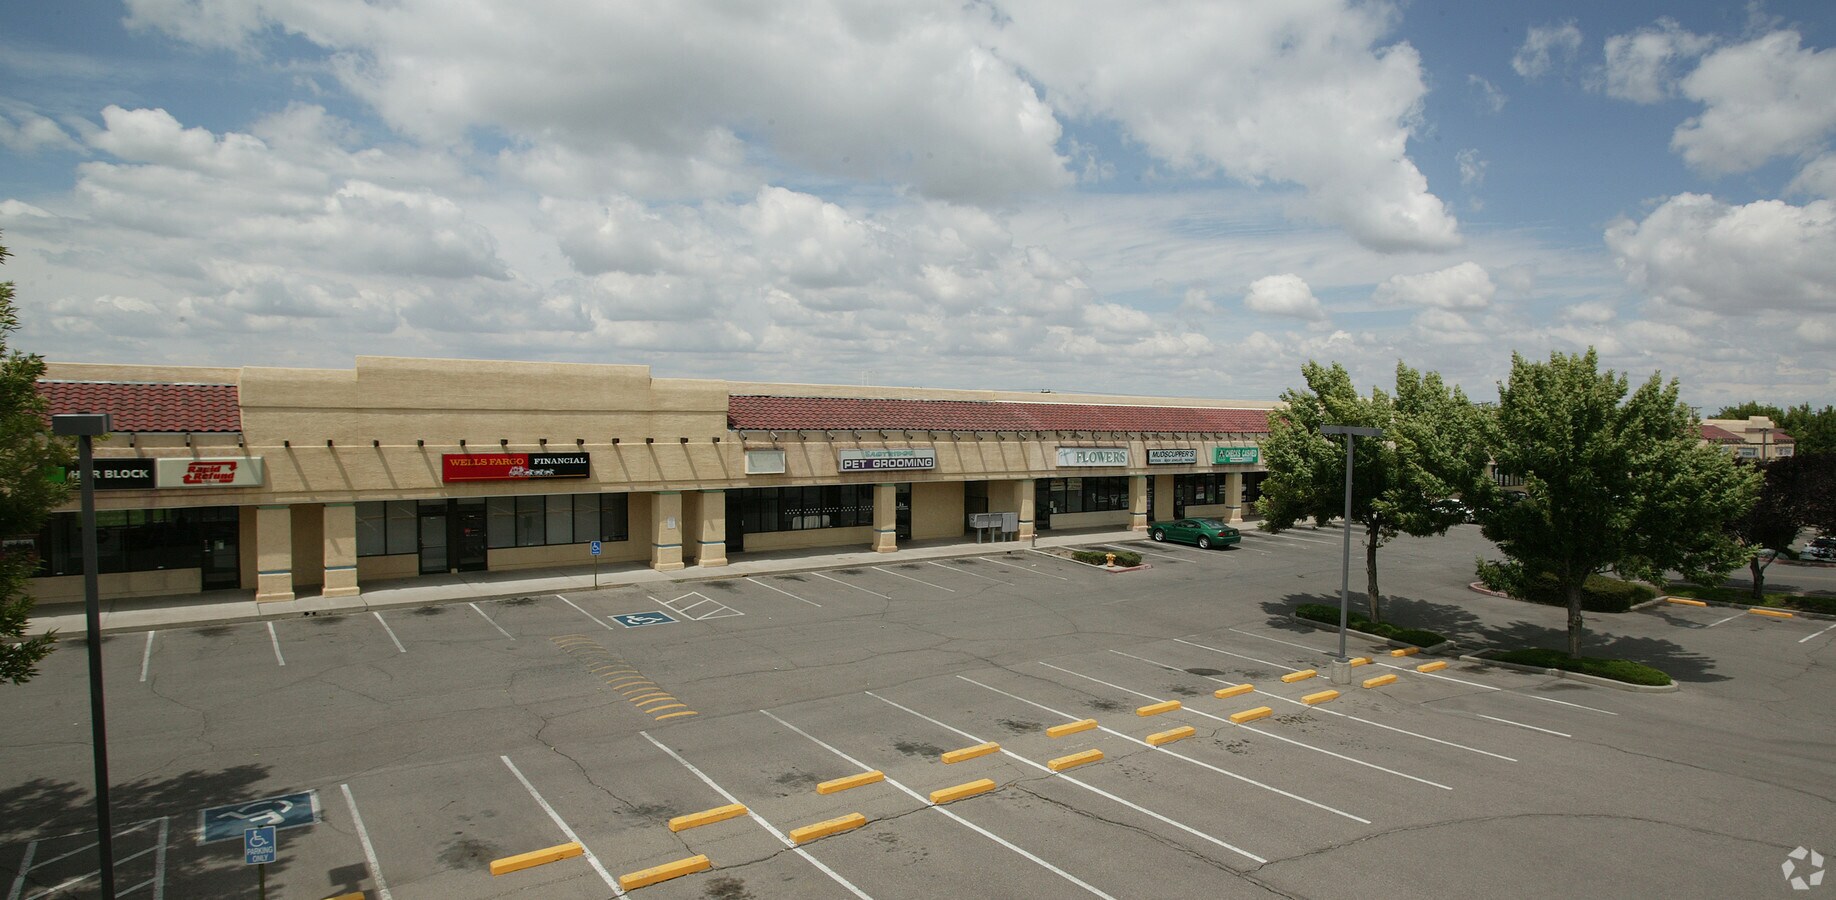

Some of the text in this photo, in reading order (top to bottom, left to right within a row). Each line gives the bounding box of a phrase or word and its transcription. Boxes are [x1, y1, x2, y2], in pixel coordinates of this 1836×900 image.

[1076, 451, 1126, 463] FLOWERS
[1152, 450, 1194, 458] MUDSCUPPER'S
[450, 457, 587, 466] WELLS FARGO FINANCIAL
[844, 458, 932, 469] PET GROOMING
[188, 465, 221, 473] Rapid
[104, 469, 149, 479] BLOCK
[193, 472, 235, 480] Refund
[247, 846, 273, 855] PARKING
